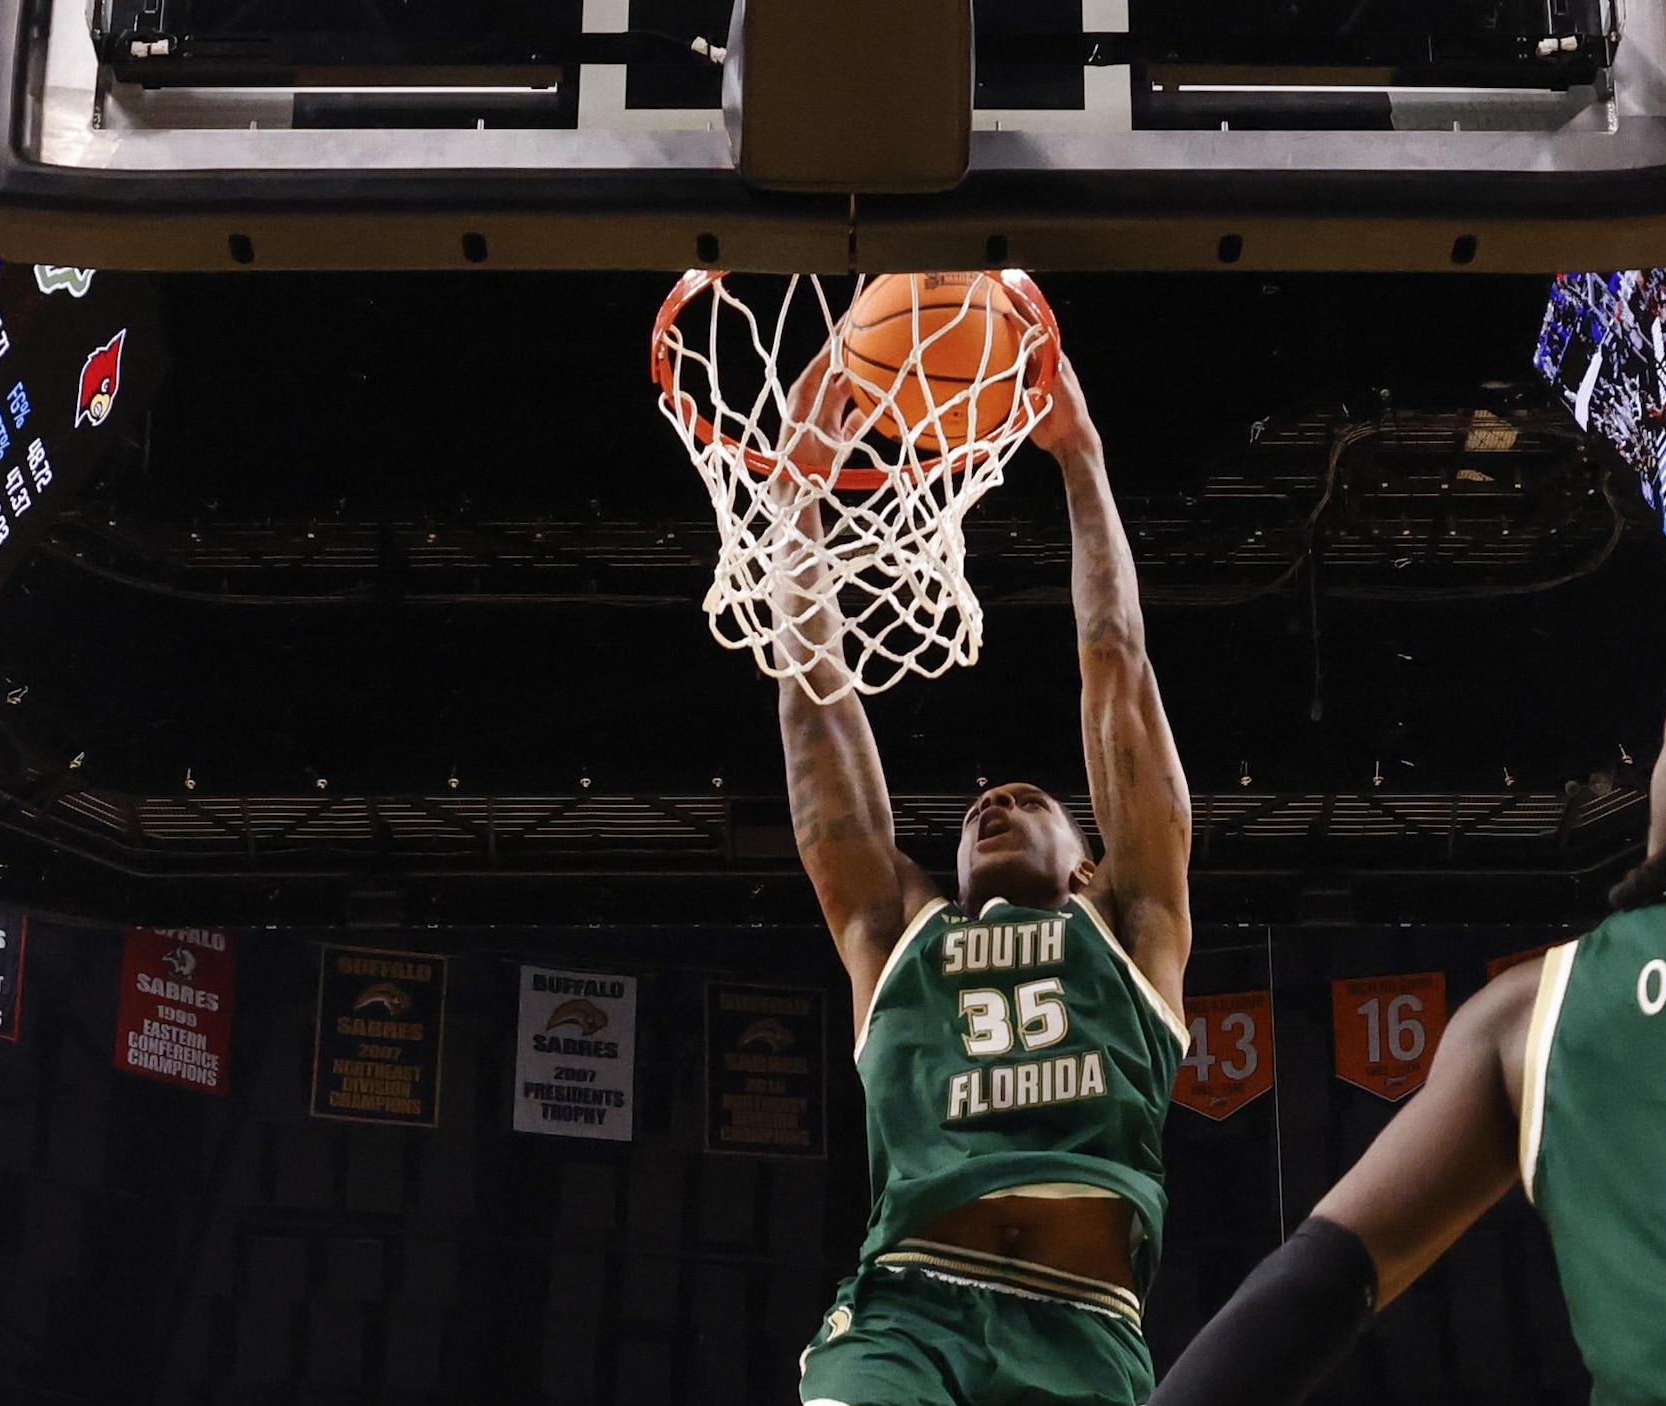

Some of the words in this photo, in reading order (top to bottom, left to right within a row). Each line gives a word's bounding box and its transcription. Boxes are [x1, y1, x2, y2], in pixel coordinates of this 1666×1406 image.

[6, 381, 32, 430] FG%
[27, 437, 53, 493] 48.72
[942, 918, 1066, 976] SOUTH
[136, 972, 219, 1011] SABRES
[533, 974, 624, 998] BUFFALO
[143, 1019, 207, 1050] EASTERN
[156, 1005, 197, 1028] 1999
[958, 977, 1068, 1057] 35
[1358, 994, 1426, 1063] 16
[127, 1031, 219, 1071] CONFERENCE
[533, 1034, 618, 1058] SABRES
[1183, 1012, 1258, 1082] 43
[127, 1048, 217, 1087] CHAMPIONS
[554, 1067, 596, 1083] 2007
[946, 1050, 1107, 1122] FLORIDA
[524, 1082, 624, 1108] PRESIDENTS
[541, 1102, 607, 1125] TROPHY
